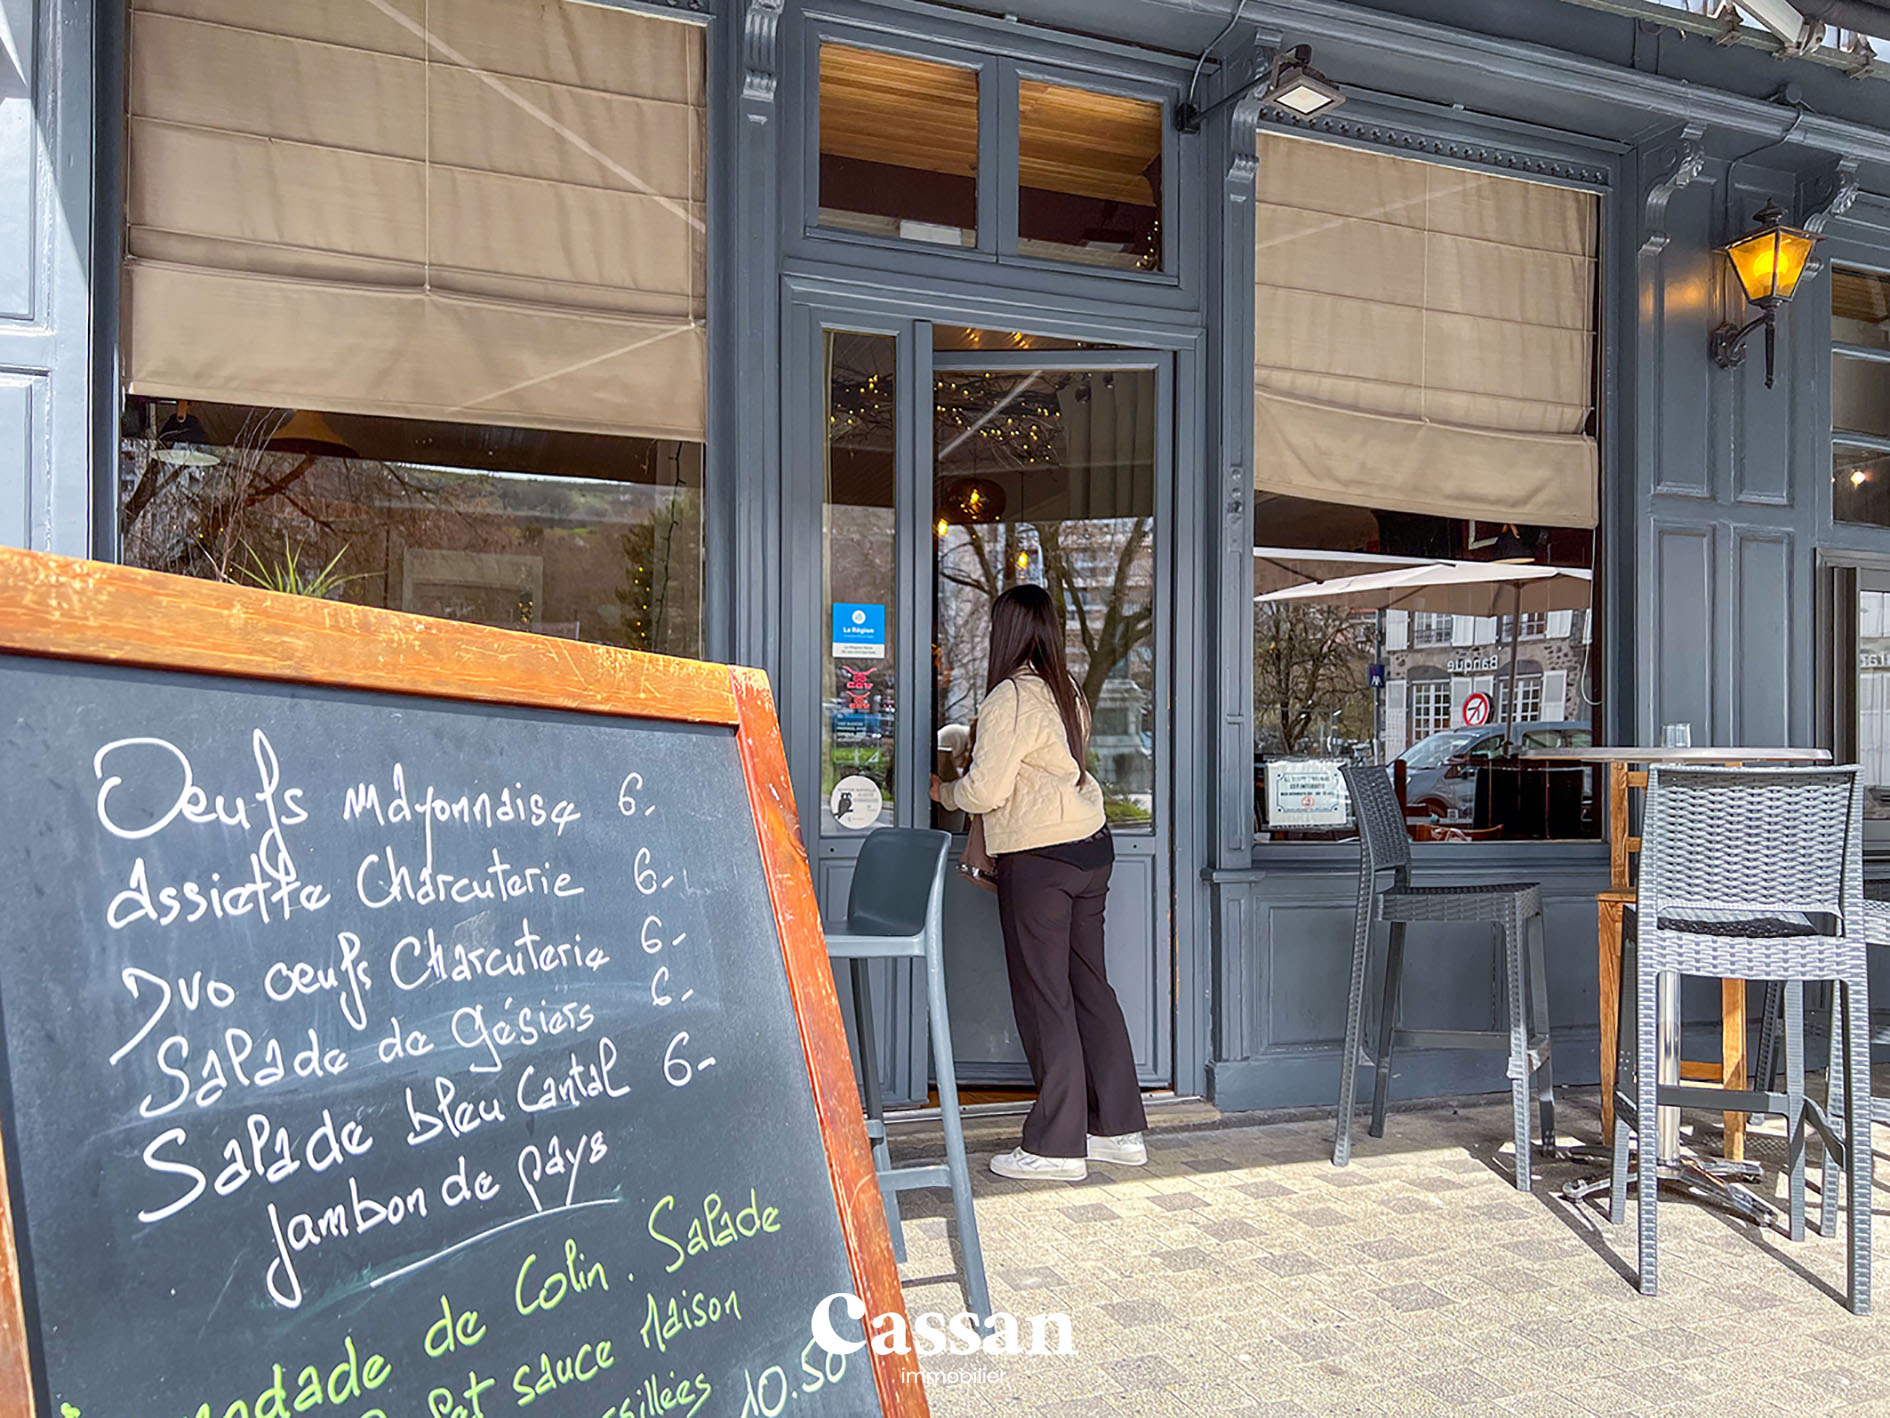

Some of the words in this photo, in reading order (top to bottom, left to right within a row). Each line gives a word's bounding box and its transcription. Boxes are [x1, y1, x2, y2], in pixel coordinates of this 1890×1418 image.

[356, 846, 585, 909] Charcuterie
[390, 918, 610, 991] Charcuterie
[138, 1026, 350, 1118] Salade
[377, 1016, 435, 1063] de
[137, 1112, 374, 1223] Salade
[406, 1076, 506, 1147] bleu
[516, 1036, 631, 1114] Cantal
[440, 1155, 500, 1207] de
[423, 1294, 487, 1358] de
[647, 1187, 781, 1273] Salade
